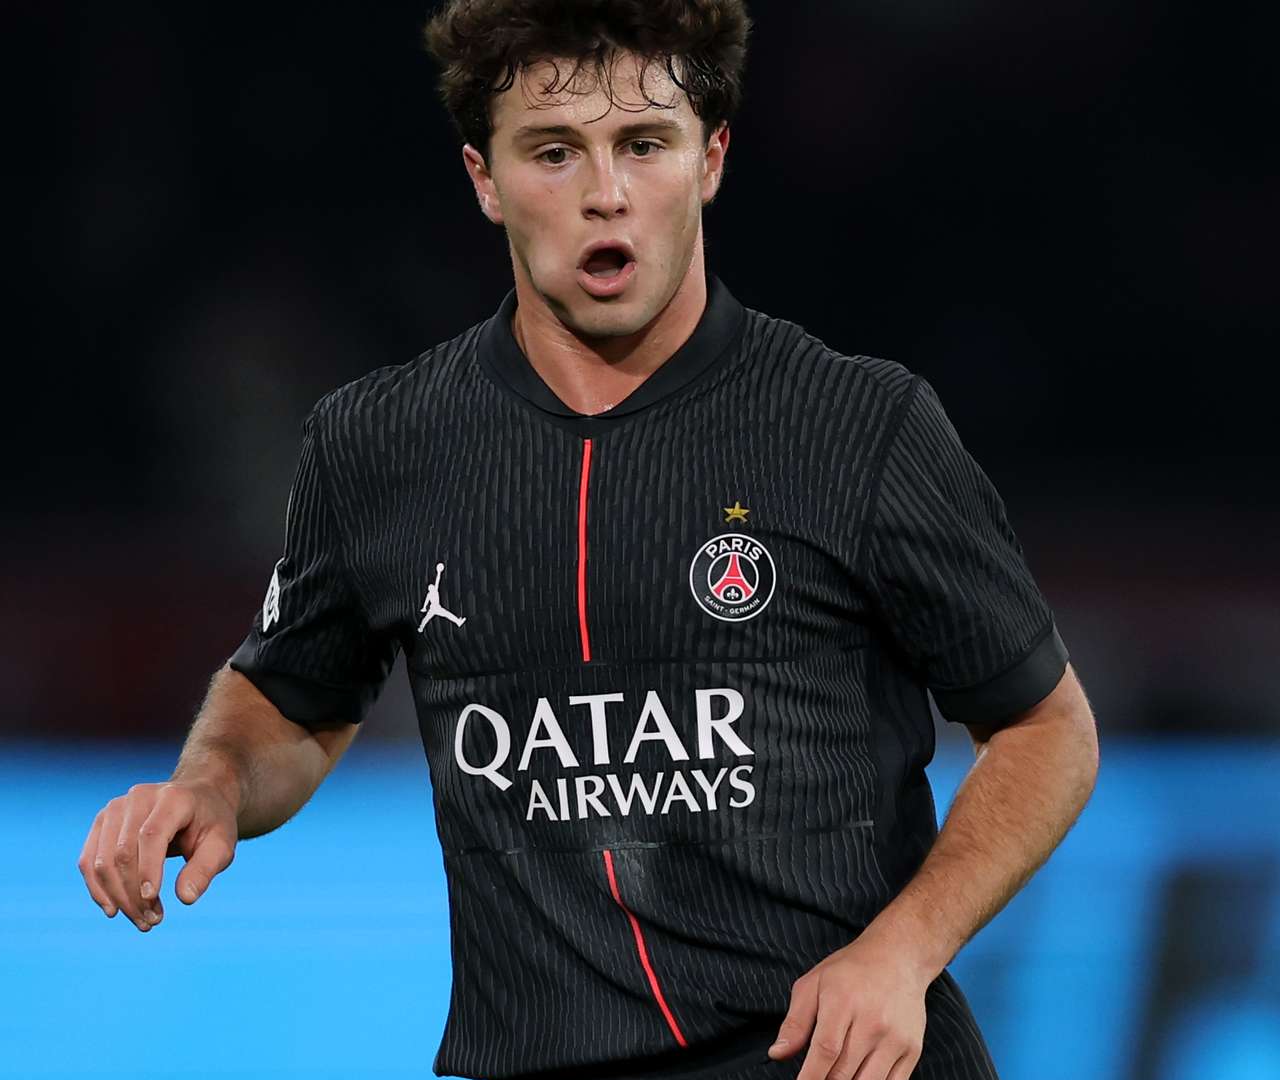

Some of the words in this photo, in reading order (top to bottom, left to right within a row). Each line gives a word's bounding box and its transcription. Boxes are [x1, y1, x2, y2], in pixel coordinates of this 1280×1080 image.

[705, 537, 763, 561] PARIS
[454, 688, 755, 791] QATAR
[526, 765, 756, 821] AIRWAYS
